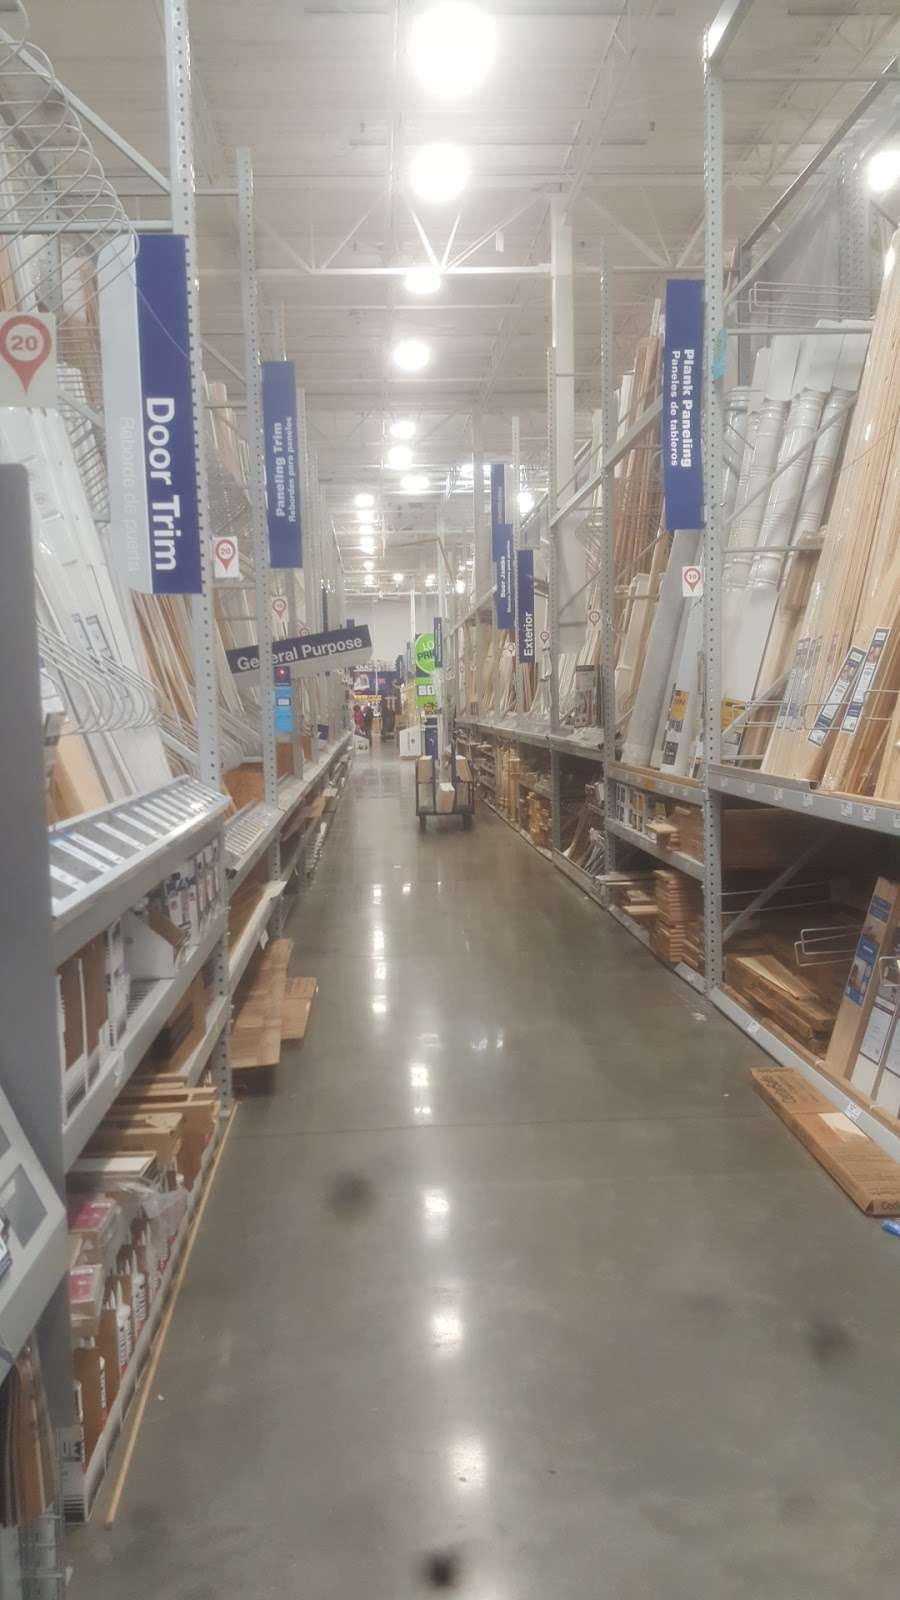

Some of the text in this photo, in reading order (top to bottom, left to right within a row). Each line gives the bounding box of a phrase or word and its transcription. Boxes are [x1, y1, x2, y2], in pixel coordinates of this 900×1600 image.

[11, 335, 38, 351] 20
[669, 350, 680, 467] Paneles de tableros
[680, 349, 695, 468] Plank Paneling
[119, 416, 137, 487] Reborde
[146, 397, 182, 571] Door Trim
[272, 422, 286, 517] Paneling Trim
[285, 417, 296, 522] Rebordes para paneles
[124, 492, 139, 514] de
[237, 637, 362, 670] Geeral Purpose
[523, 612, 533, 657] Exterior
